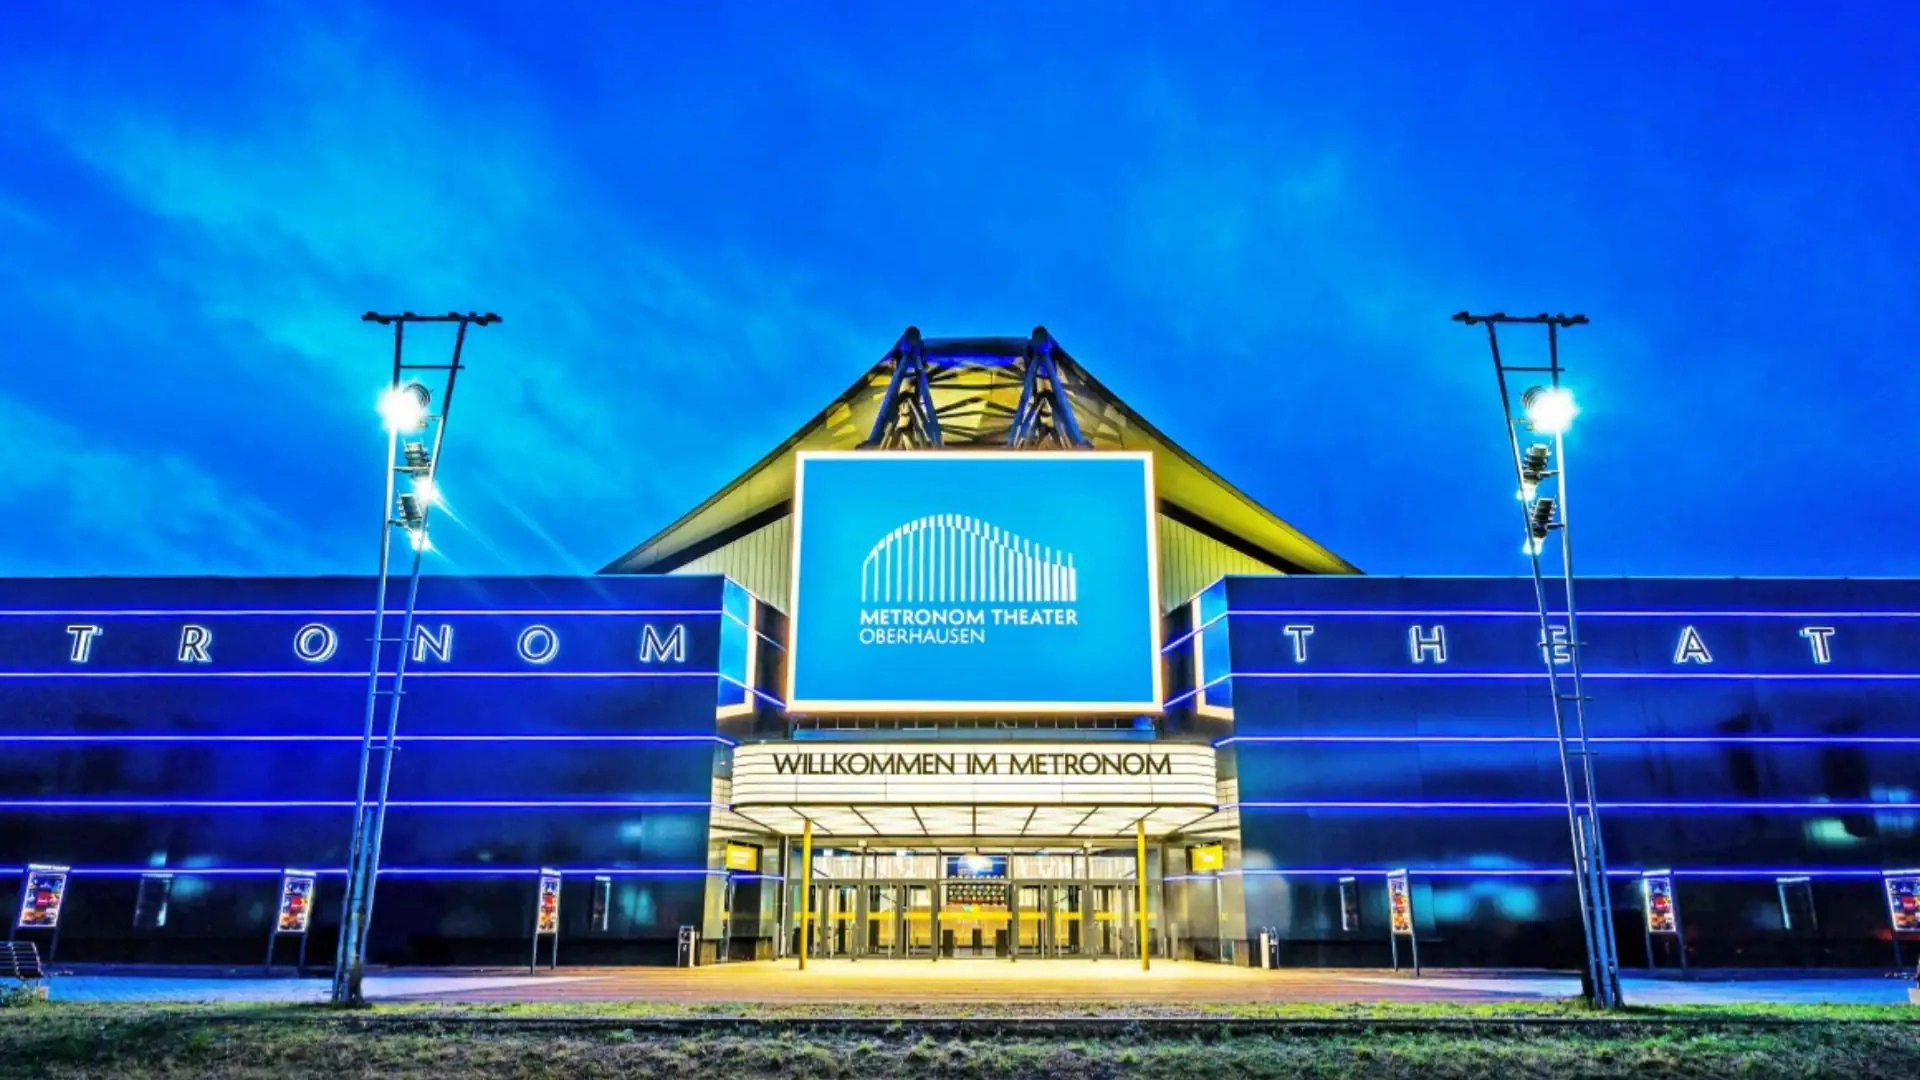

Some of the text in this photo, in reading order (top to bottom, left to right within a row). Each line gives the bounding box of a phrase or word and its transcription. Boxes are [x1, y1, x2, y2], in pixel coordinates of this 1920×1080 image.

[859, 608, 1078, 626] METRONOM THEATER
[859, 627, 986, 645] OBERHAUSEN
[772, 752, 1172, 776] WILLKOMMEN IM METRONOM
